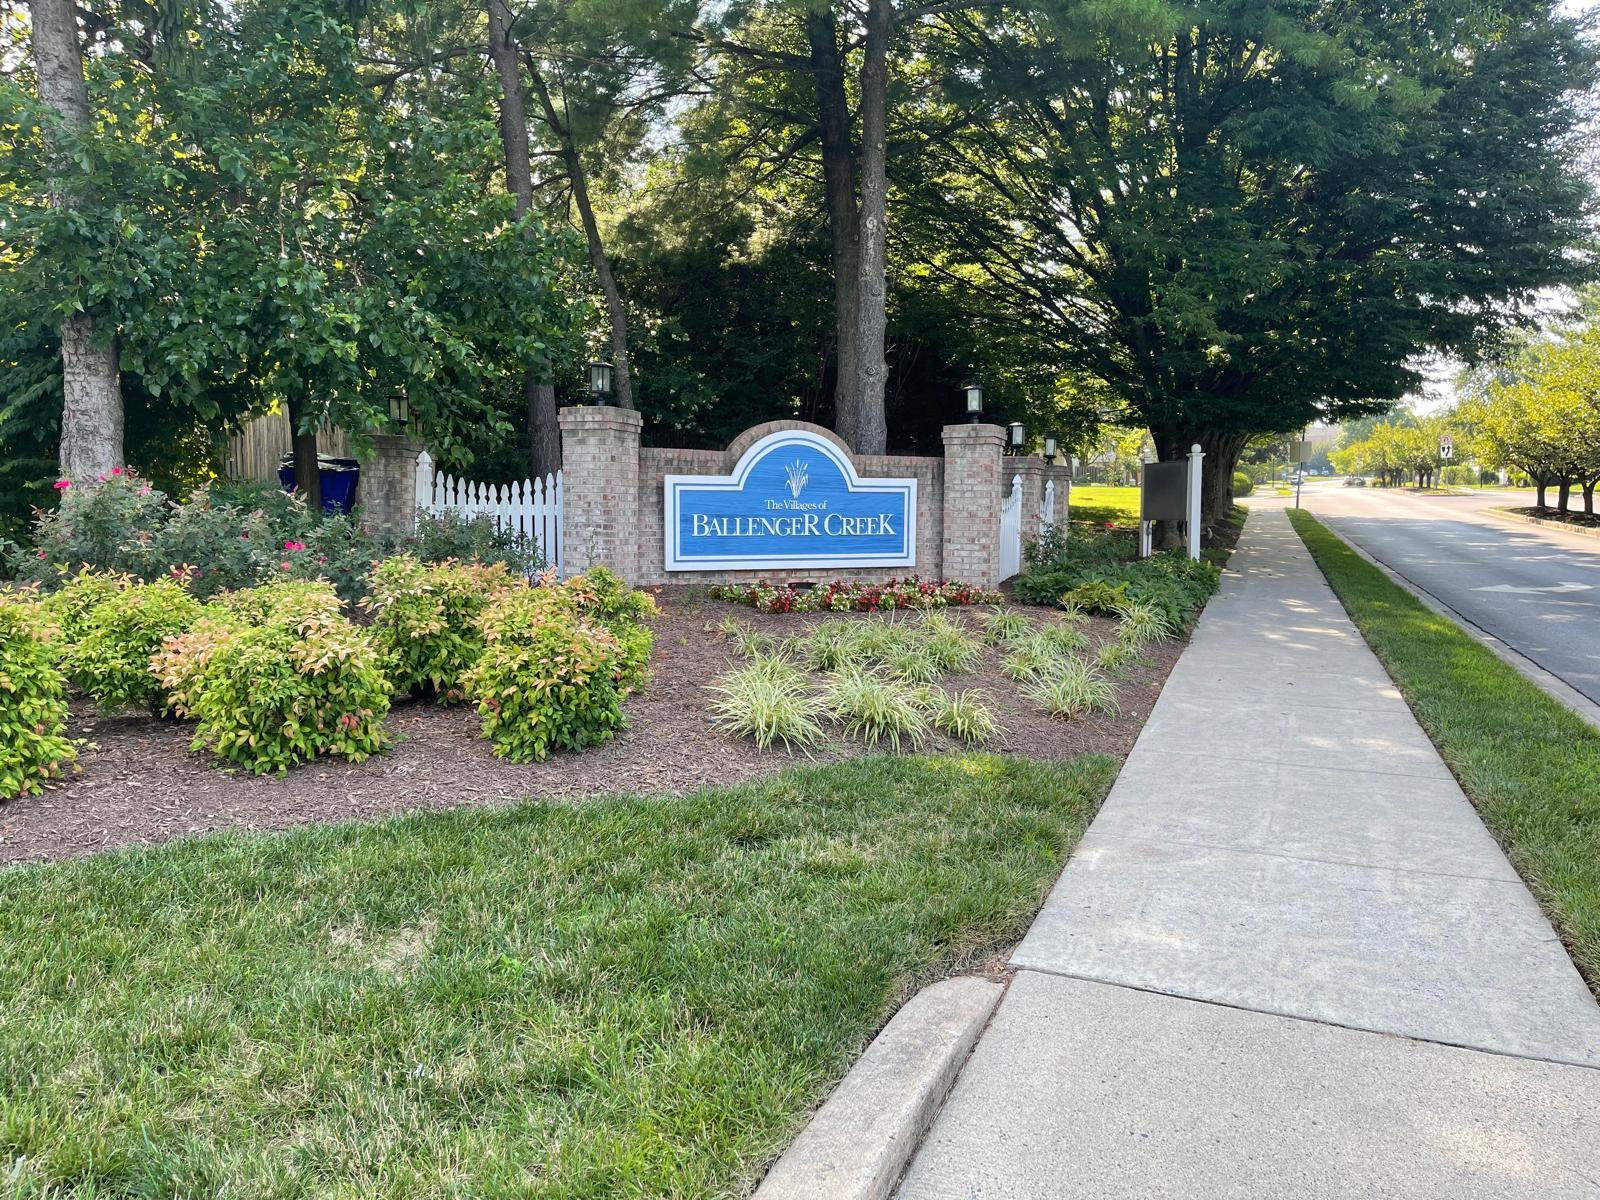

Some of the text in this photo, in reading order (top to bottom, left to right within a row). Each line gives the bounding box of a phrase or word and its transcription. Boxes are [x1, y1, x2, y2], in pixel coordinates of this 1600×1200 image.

[764, 499, 828, 512] The Villages of
[691, 513, 896, 537] BALLENGER CREEK
